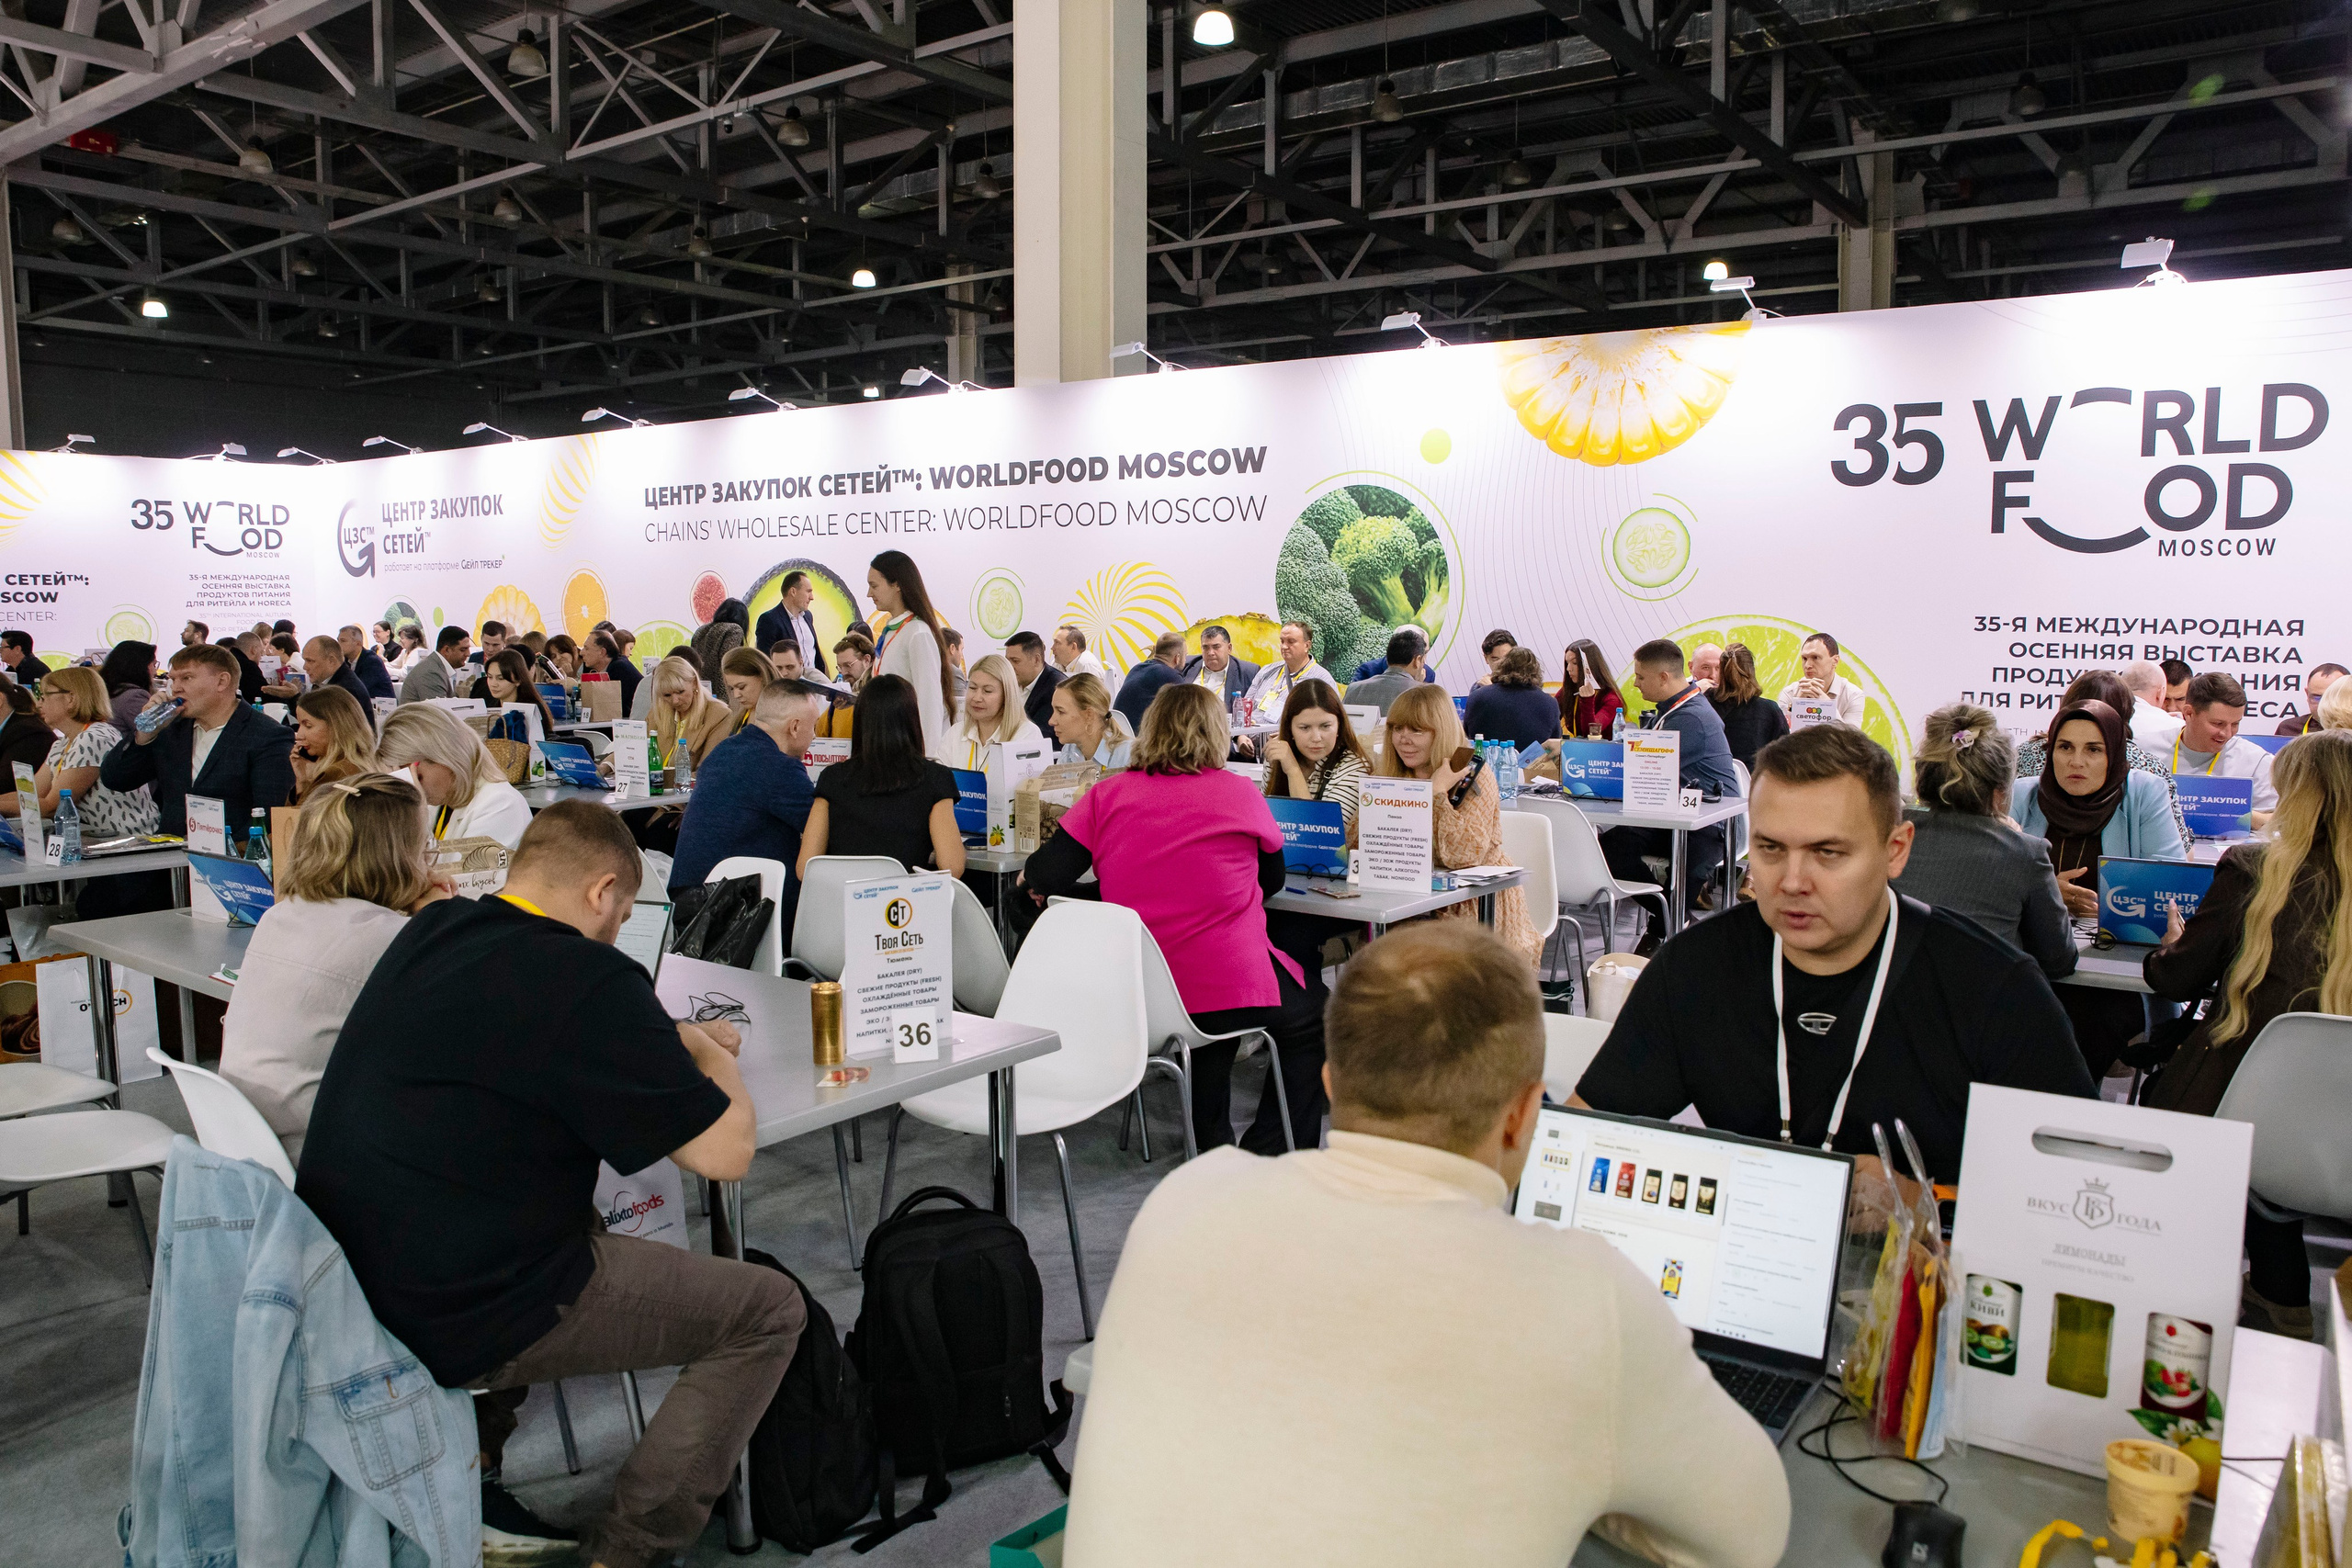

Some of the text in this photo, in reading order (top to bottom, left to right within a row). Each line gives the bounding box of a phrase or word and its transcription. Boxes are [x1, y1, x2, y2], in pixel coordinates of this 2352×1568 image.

[1830, 401, 1945, 488] 35
[644, 446, 1268, 511] ЦЕНТР ЗАКУПОК СЕТЕЙ™: WORLDFOOD MOSCOW
[130, 499, 175, 530] 35
[381, 494, 504, 528] ЦЕНТР ЗАКУПОК
[644, 494, 1268, 543] CHAINS' WHOLESALE CENTER: WORLDFOOD MOSCOW
[383, 526, 431, 555] СЕТЕЙ™
[2157, 537, 2277, 558] MOSCOW
[384, 562, 413, 572] работает
[424, 561, 459, 572] платформе
[0, 591, 59, 604] SCOW
[207, 599, 247, 607] РИТЕЙЛА
[1973, 615, 2304, 639] 35-Я МЕЖДУНАРОДНАЯ
[2008, 642, 2303, 664] ОСЕННЯЯ ВЫСТАВКА
[1992, 666, 2123, 687] ПРОДУ
[2244, 701, 2300, 718] ECA
[616, 782, 628, 793] 27
[1374, 797, 1429, 808] СКИДКИНО
[1682, 795, 1698, 808] 34
[2200, 795, 2248, 805] ЗАКУПОК
[1298, 823, 1340, 835] ЗАКУПОК
[49, 843, 61, 857] 28
[1351, 859, 1360, 874] 3
[2154, 890, 2199, 903] ЦЕНТР
[2154, 903, 2199, 915] СЕЕЙ
[886, 956, 913, 964] Тюмень
[876, 967, 922, 980] БАКАЛЕЯ (DRY)
[856, 976, 943, 994] СВЕЖИЕ ПРОДУКТЫ (FRESH)
[912, 986, 937, 995] ТОВАРЫ
[860, 997, 940, 1015] ЗАМОРОЖЕННЫЕ ТОВАРЫ
[855, 1028, 888, 1038] НАПИТКИ,
[898, 1021, 932, 1048] 36
[603, 1193, 665, 1228] alixtofoods
[2026, 1197, 2162, 1232] ВКУС ГОДА
